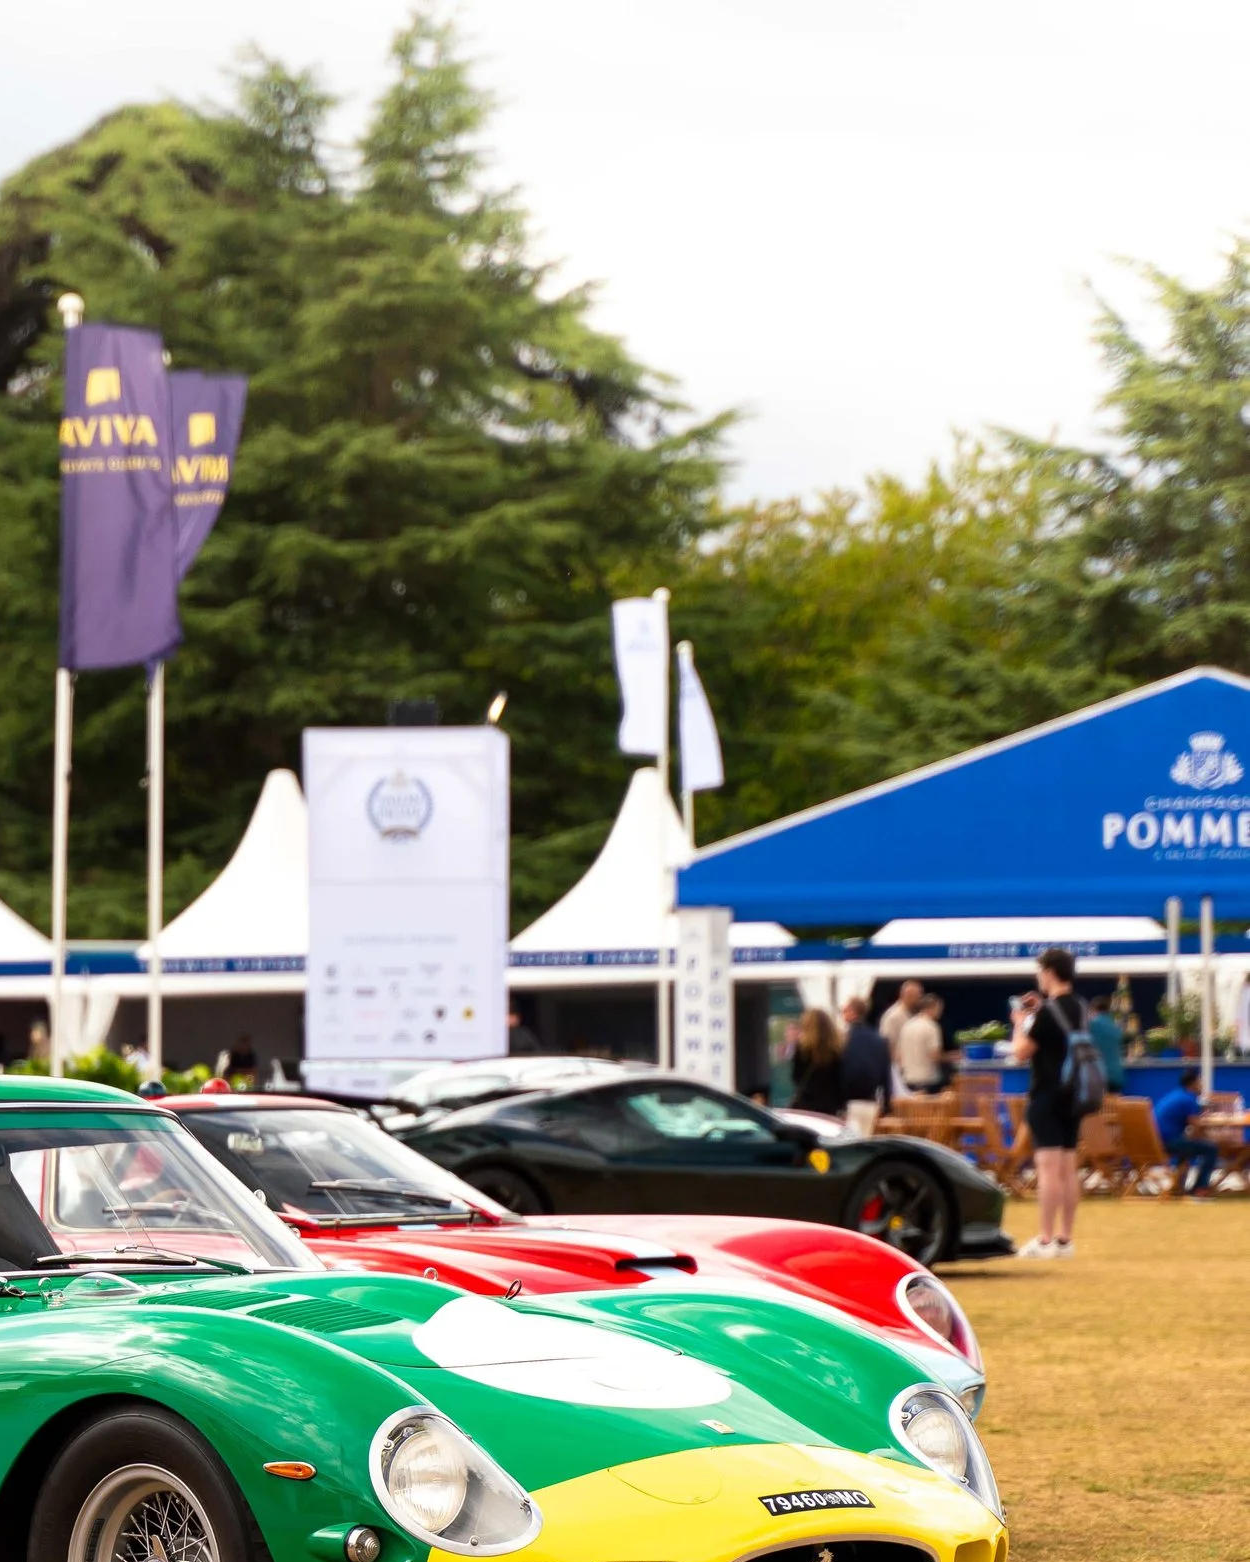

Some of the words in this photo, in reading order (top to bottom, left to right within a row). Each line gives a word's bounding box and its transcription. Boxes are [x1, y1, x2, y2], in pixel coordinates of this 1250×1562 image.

[1102, 811, 1250, 850] POMME
[761, 1491, 827, 1513] 79460
[835, 1490, 871, 1506] MO
